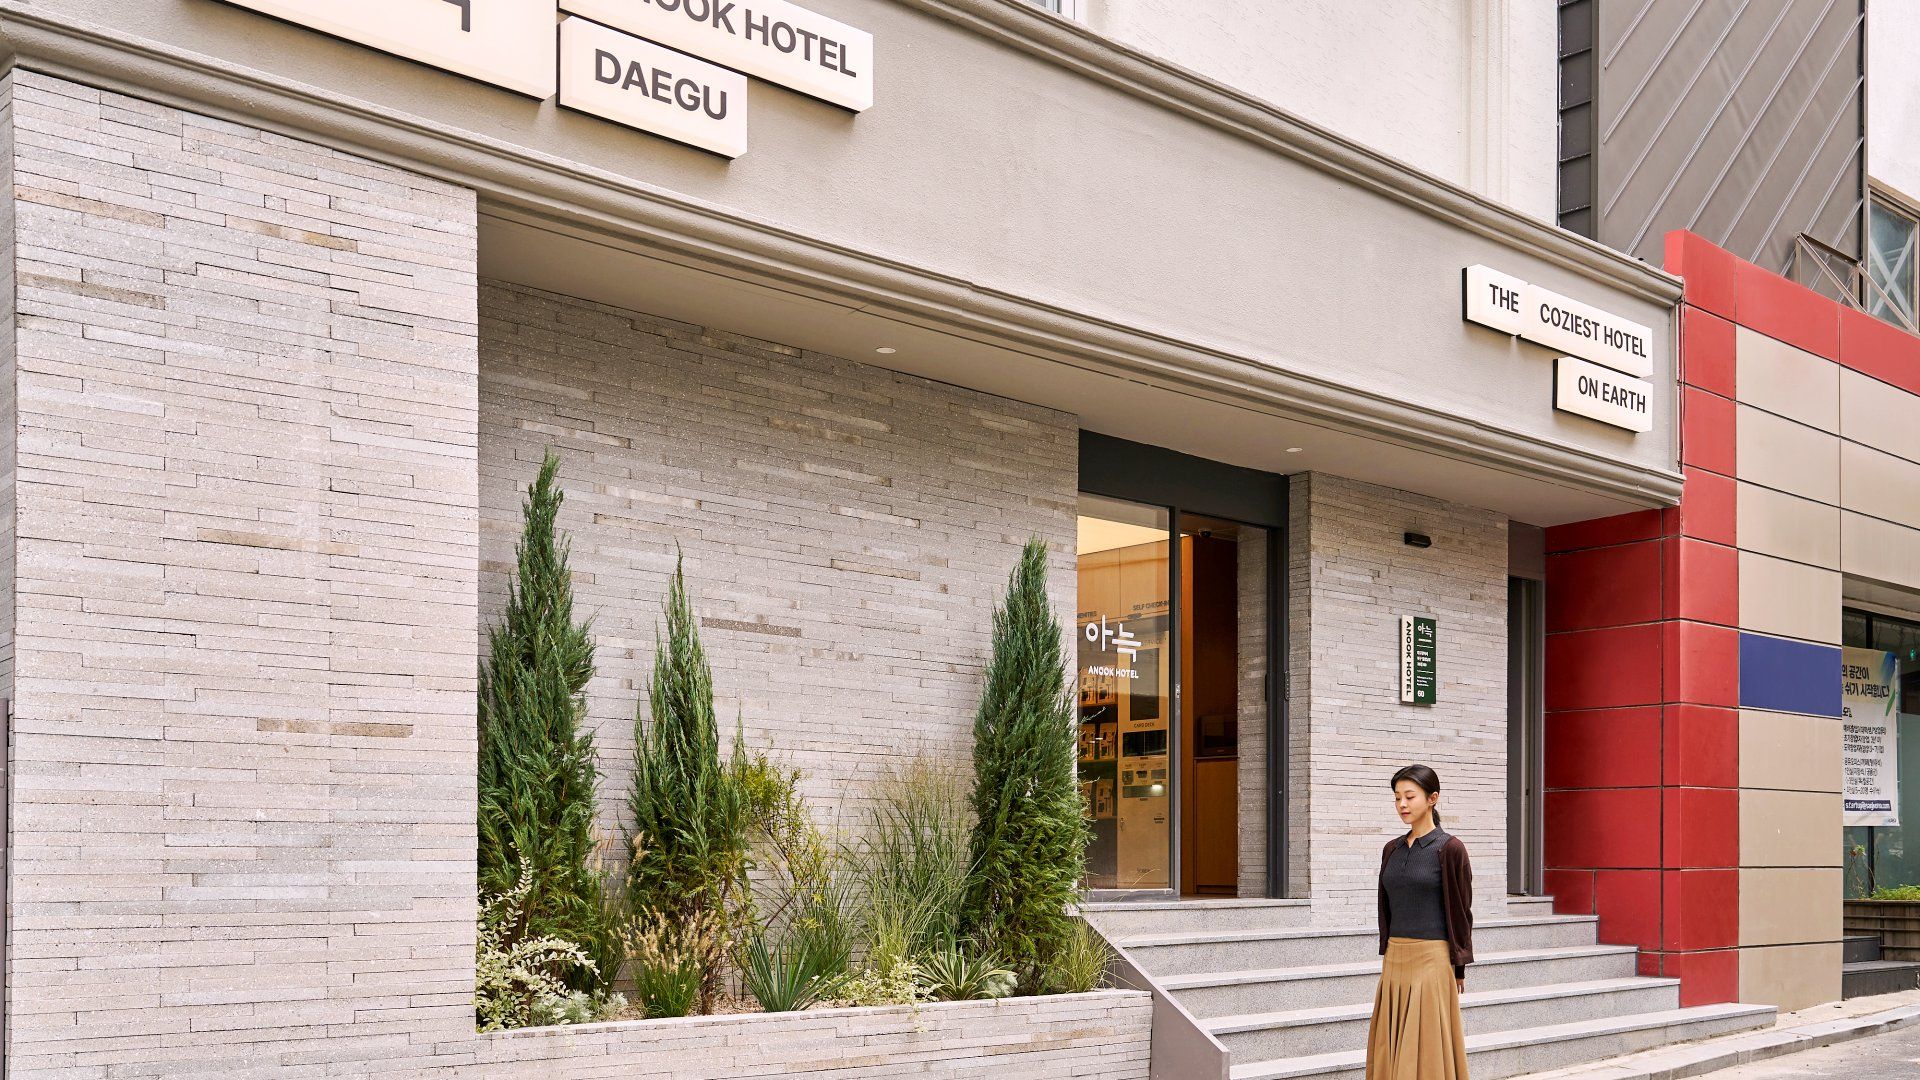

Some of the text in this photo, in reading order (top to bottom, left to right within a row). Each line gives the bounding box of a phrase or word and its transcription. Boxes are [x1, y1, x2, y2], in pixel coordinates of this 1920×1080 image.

[745, 8, 857, 78] HOTEL
[595, 48, 727, 121] DAEGU
[1489, 283, 1647, 358] THE COZIEST HOTEL
[1578, 375, 1646, 413] ON EARTH
[1085, 614, 1142, 663] 아늑
[1088, 665, 1139, 679] ANOOK HOTEL
[1849, 665, 1869, 680] 공간이
